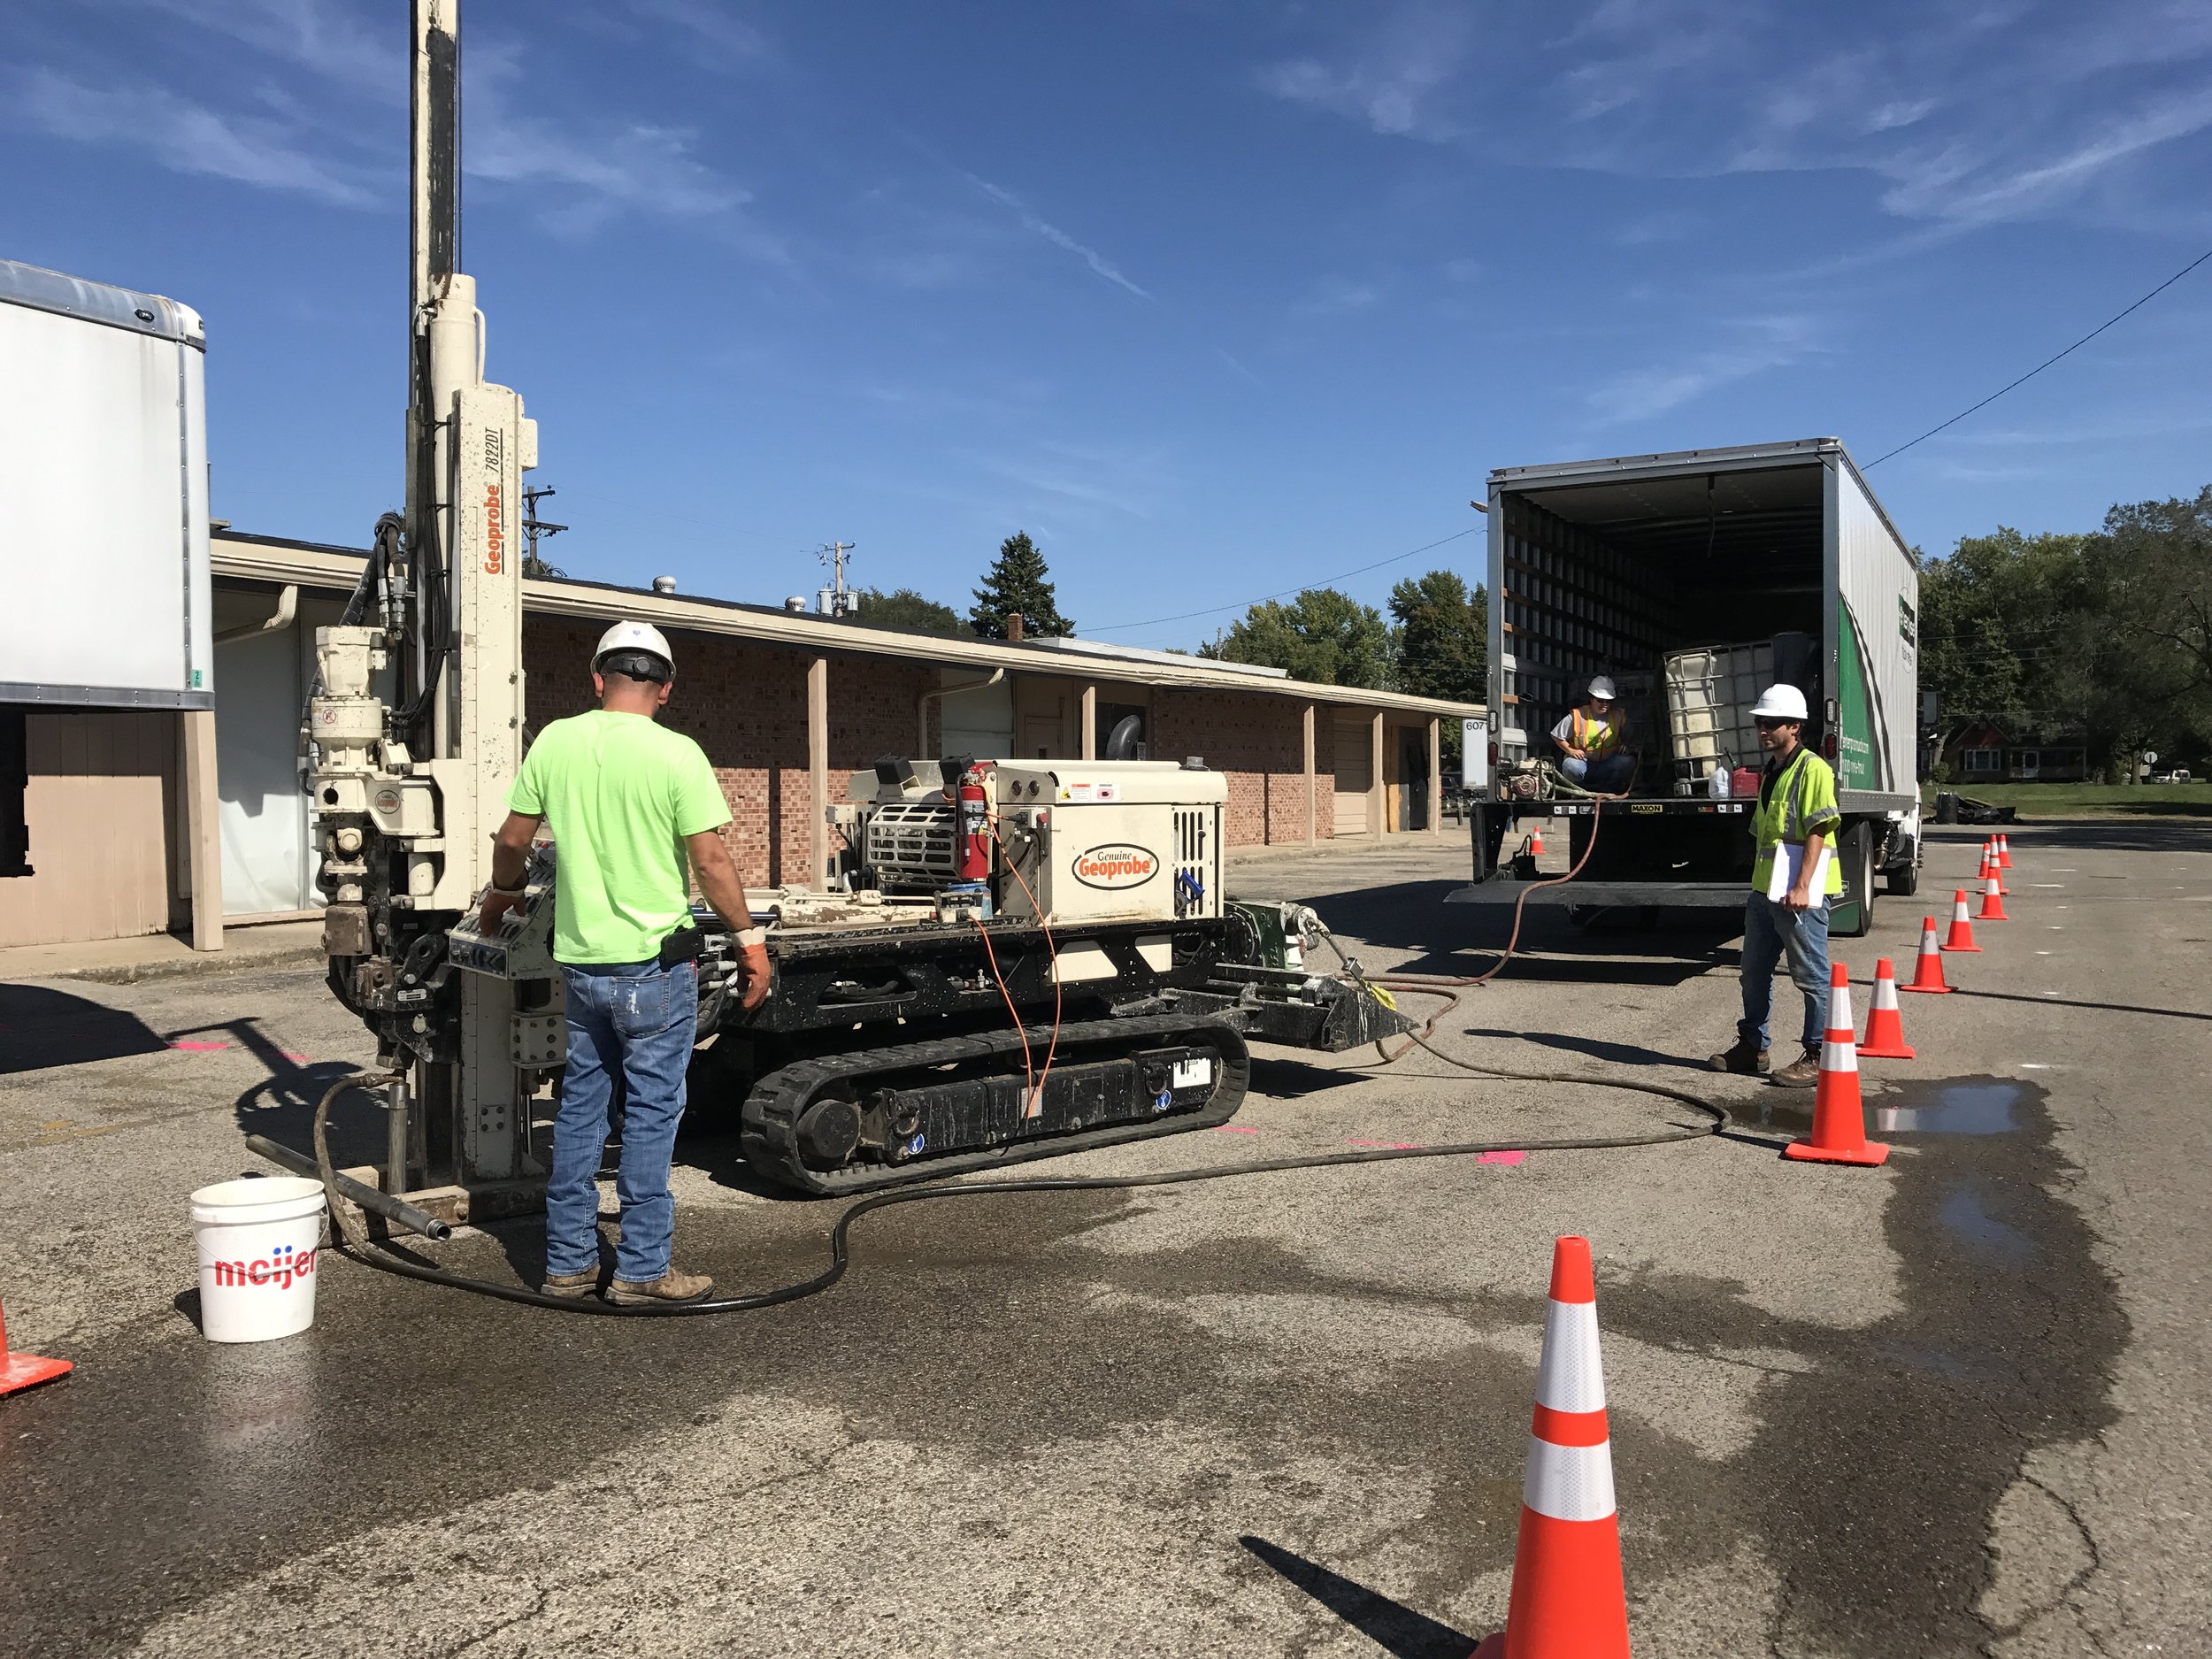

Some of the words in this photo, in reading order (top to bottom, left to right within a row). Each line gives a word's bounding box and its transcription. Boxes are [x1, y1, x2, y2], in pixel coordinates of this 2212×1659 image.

[485, 426, 499, 473] 7822DT
[483, 484, 503, 575] Geoprobe
[1465, 721, 1487, 731] 607
[1079, 856, 1151, 880] Geoprobe
[1097, 850, 1133, 862] Genuine
